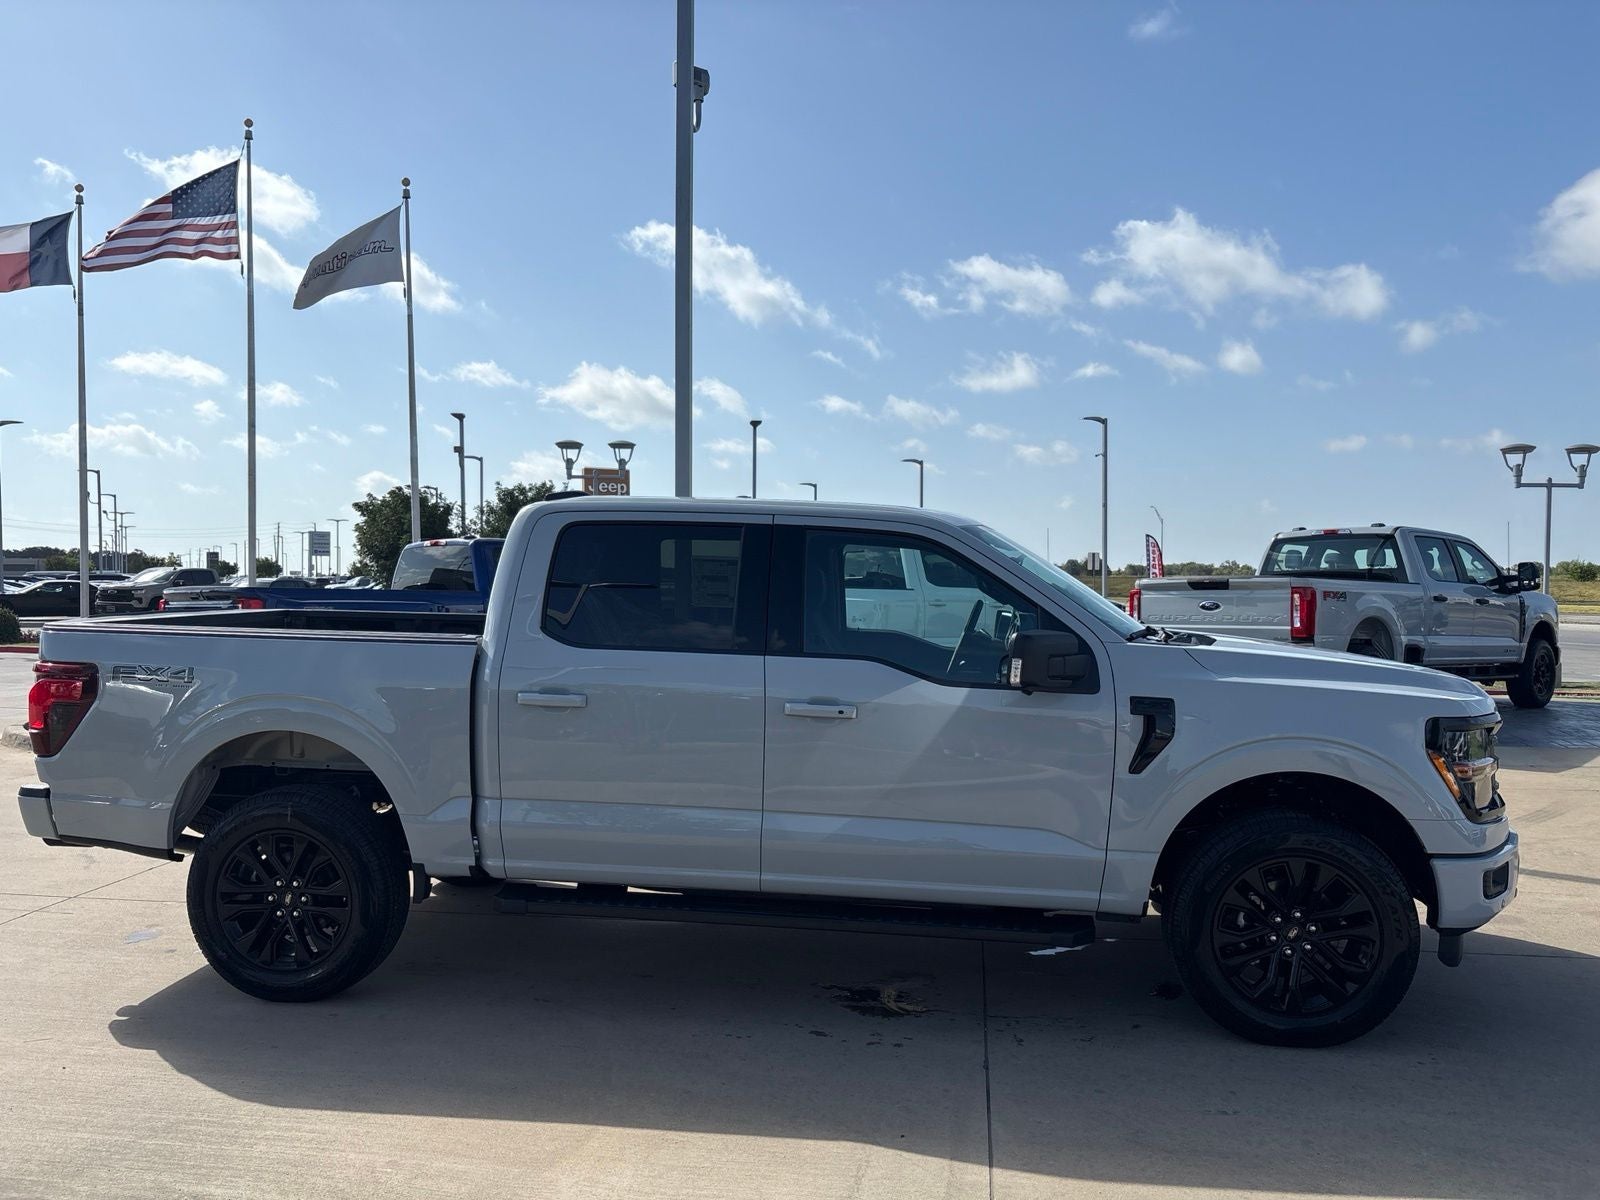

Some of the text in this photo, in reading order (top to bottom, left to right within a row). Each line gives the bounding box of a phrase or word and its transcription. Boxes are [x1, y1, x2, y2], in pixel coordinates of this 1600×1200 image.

[1148, 613, 1285, 622] SUPER DUTY
[112, 665, 195, 683] FX4
